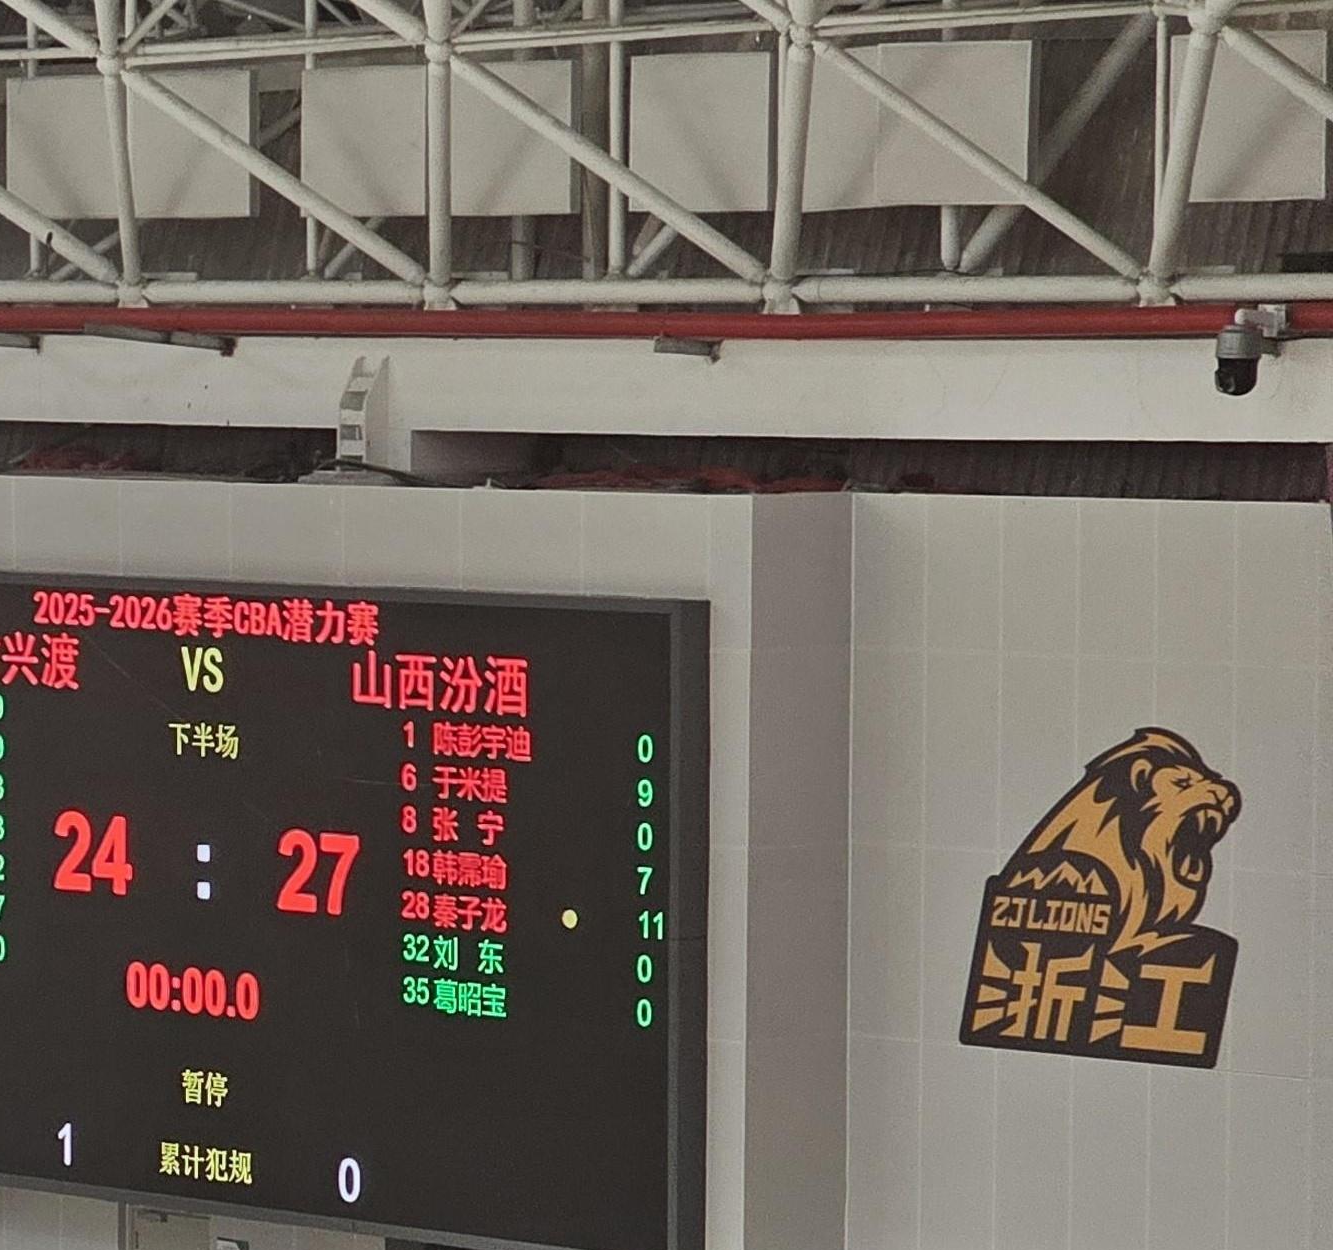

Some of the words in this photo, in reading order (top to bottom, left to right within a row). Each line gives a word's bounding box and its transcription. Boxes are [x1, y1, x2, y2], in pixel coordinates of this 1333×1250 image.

[33, 591, 379, 646] 2025-2026赛季CBA潜力赛
[181, 646, 224, 693] VS
[351, 649, 529, 717] 山西汾酒
[168, 722, 239, 759] 下半场
[403, 720, 414, 748] 1
[637, 734, 654, 763] 0
[401, 763, 417, 791] 6
[432, 767, 507, 804] 于米提
[637, 779, 654, 808] 9
[401, 806, 417, 833] 8
[637, 823, 653, 851] 0
[53, 811, 133, 896] 24
[276, 828, 361, 915] 27
[637, 866, 653, 895] 7
[432, 893, 507, 933] 秦子龙
[638, 910, 664, 940] 11
[990, 895, 1112, 935] ZJLIONS
[126, 960, 260, 1021] 00:00.0
[636, 954, 653, 983] 0
[433, 978, 507, 1018] 葛昭宝
[636, 998, 653, 1027] 0
[972, 940, 1217, 1055] 浙江
[182, 1069, 229, 1108] 暂停
[57, 1121, 73, 1167] 1
[159, 1141, 253, 1185] 累计犯规
[338, 1156, 361, 1203] 0
